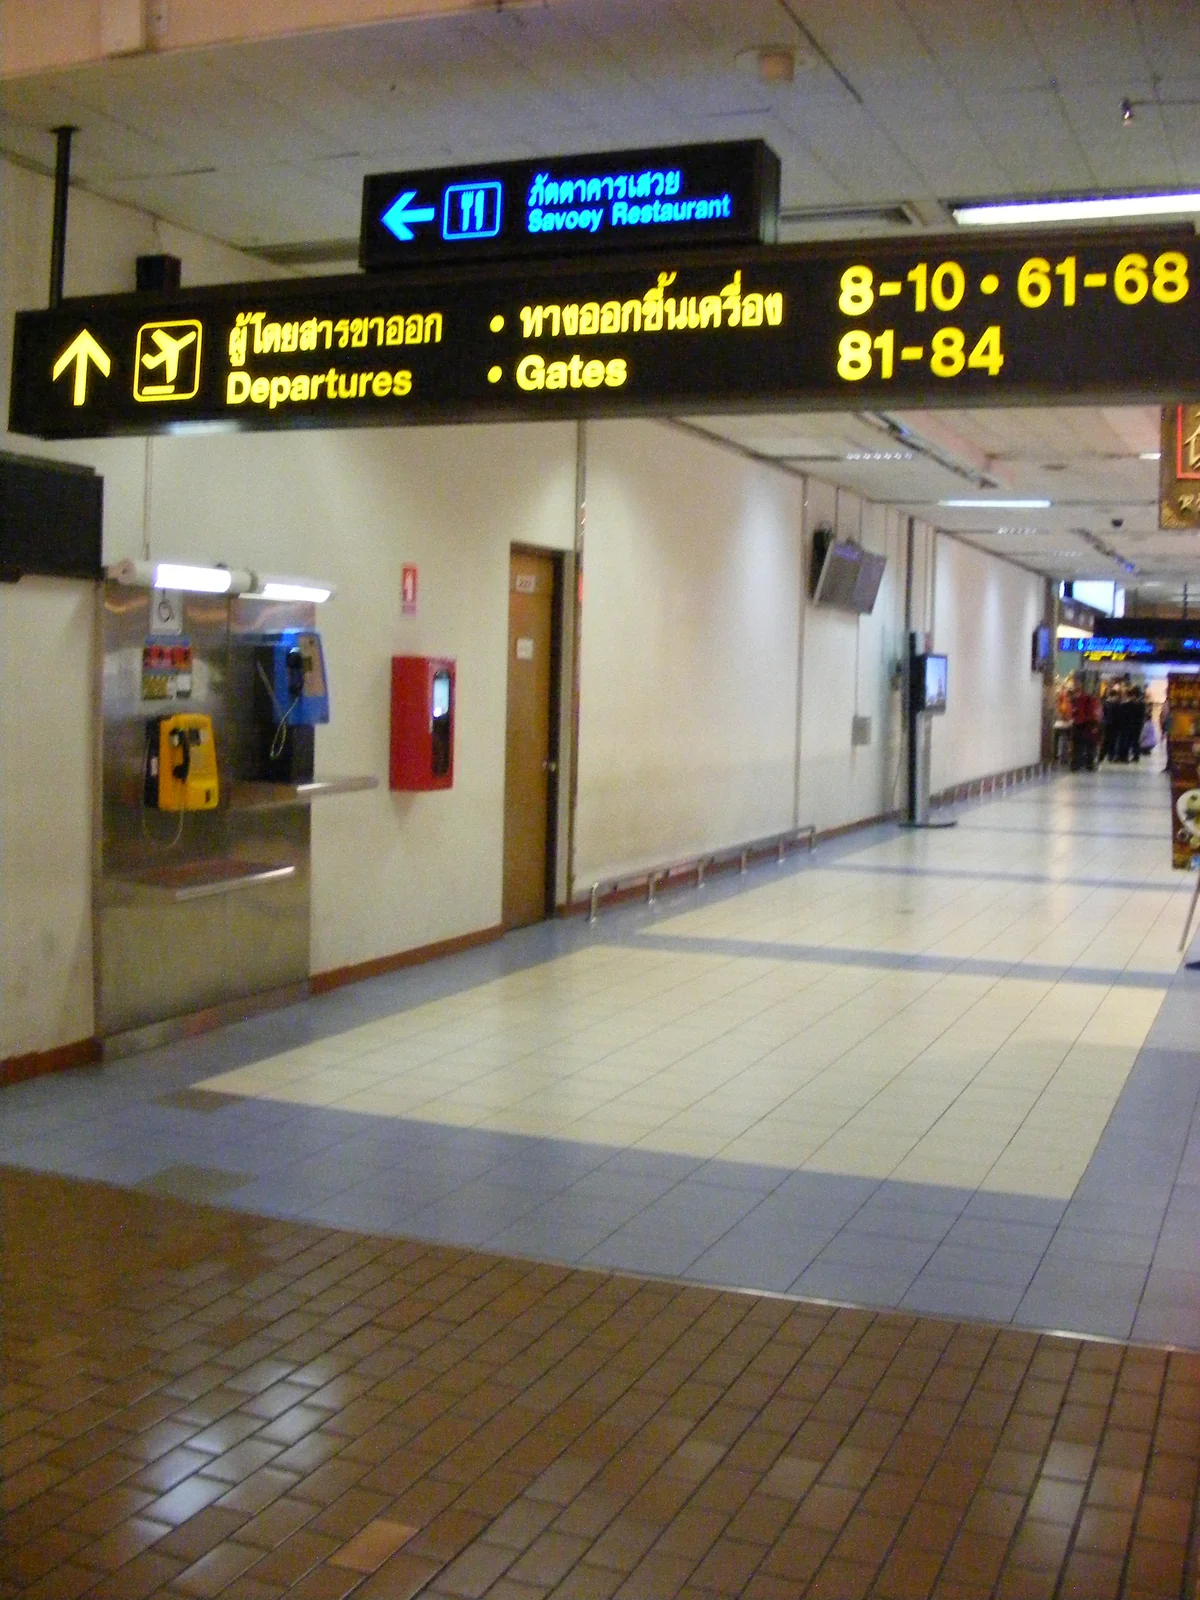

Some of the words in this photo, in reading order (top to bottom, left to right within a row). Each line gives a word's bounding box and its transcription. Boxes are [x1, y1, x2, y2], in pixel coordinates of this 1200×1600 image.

[527, 170, 681, 208] ภัตตาคารเสวย
[527, 207, 605, 234] Savoey
[611, 193, 731, 227] Restaurant
[519, 269, 784, 339] ทางออกขึ้นเครื่อง
[838, 261, 966, 317] 8-10
[1016, 251, 1190, 309] 61-68
[227, 312, 444, 367] ผู้โดยสารขาออก
[836, 325, 1005, 382] 81-84
[226, 366, 413, 410] Departures
[515, 354, 628, 391] Gates
